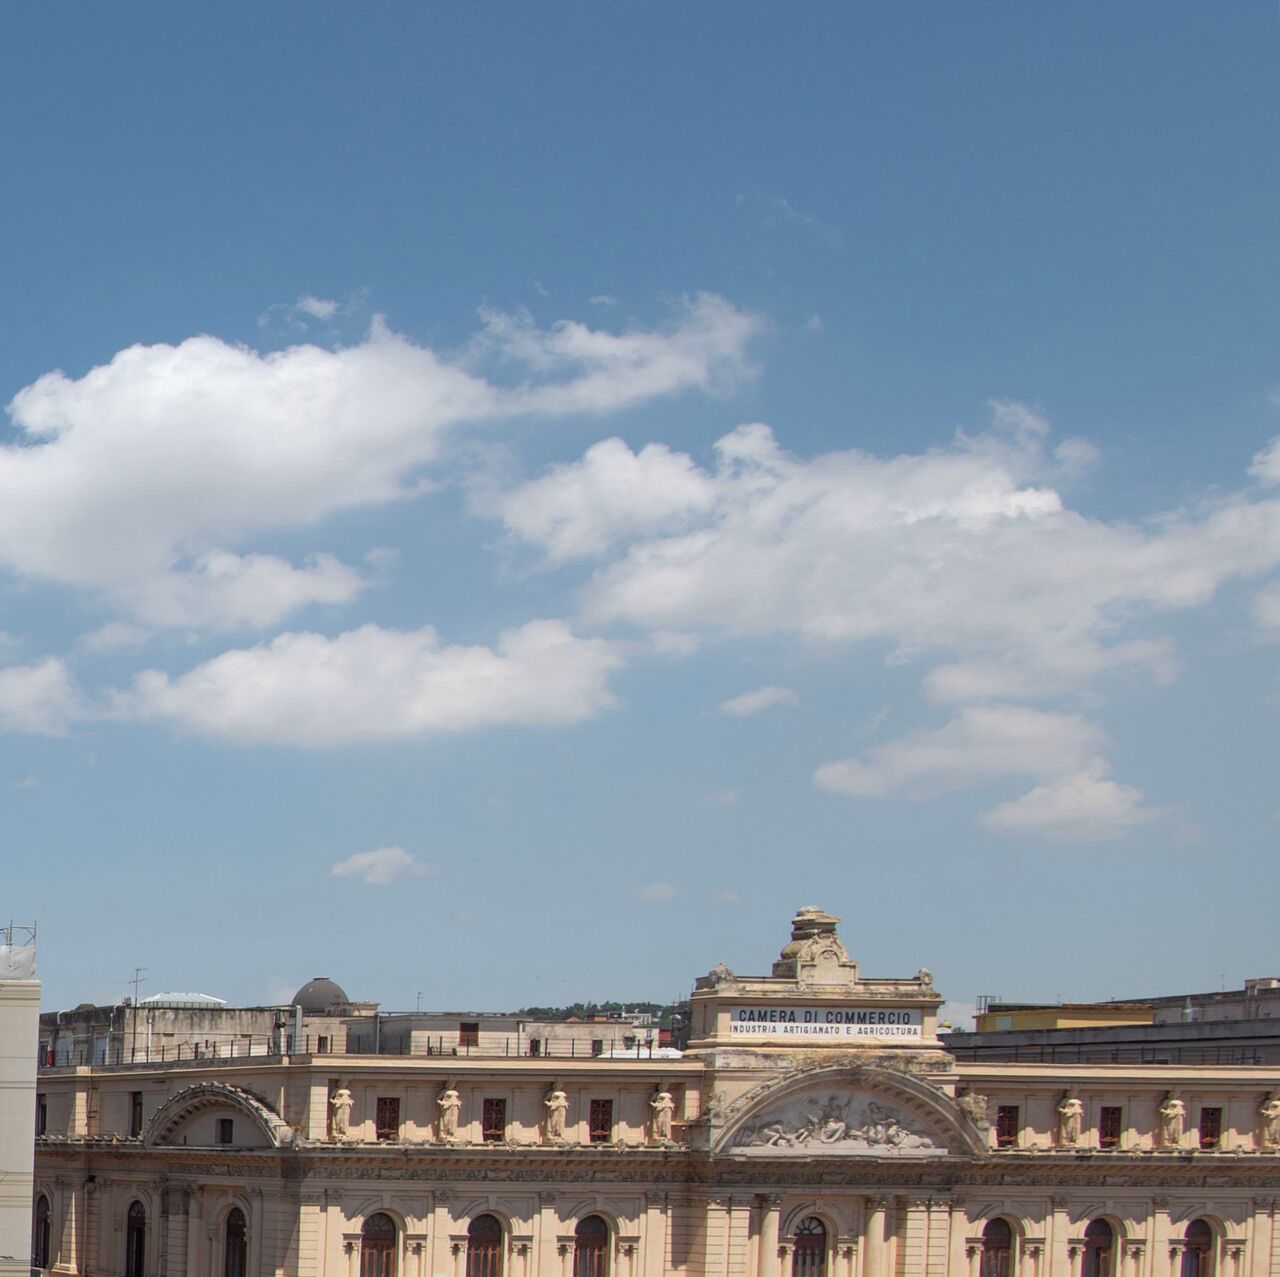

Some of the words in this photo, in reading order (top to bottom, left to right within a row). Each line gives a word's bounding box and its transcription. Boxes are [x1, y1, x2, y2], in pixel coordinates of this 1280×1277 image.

[739, 1009, 796, 1023] CAMERA
[804, 1010, 818, 1024] DI
[825, 1011, 911, 1025] COMMERCIO
[729, 1024, 777, 1033] INDUSTRIA
[783, 1025, 840, 1035] ARTIGIANATO
[846, 1026, 852, 1035] E
[857, 1026, 918, 1036] AGRICOLTURA
